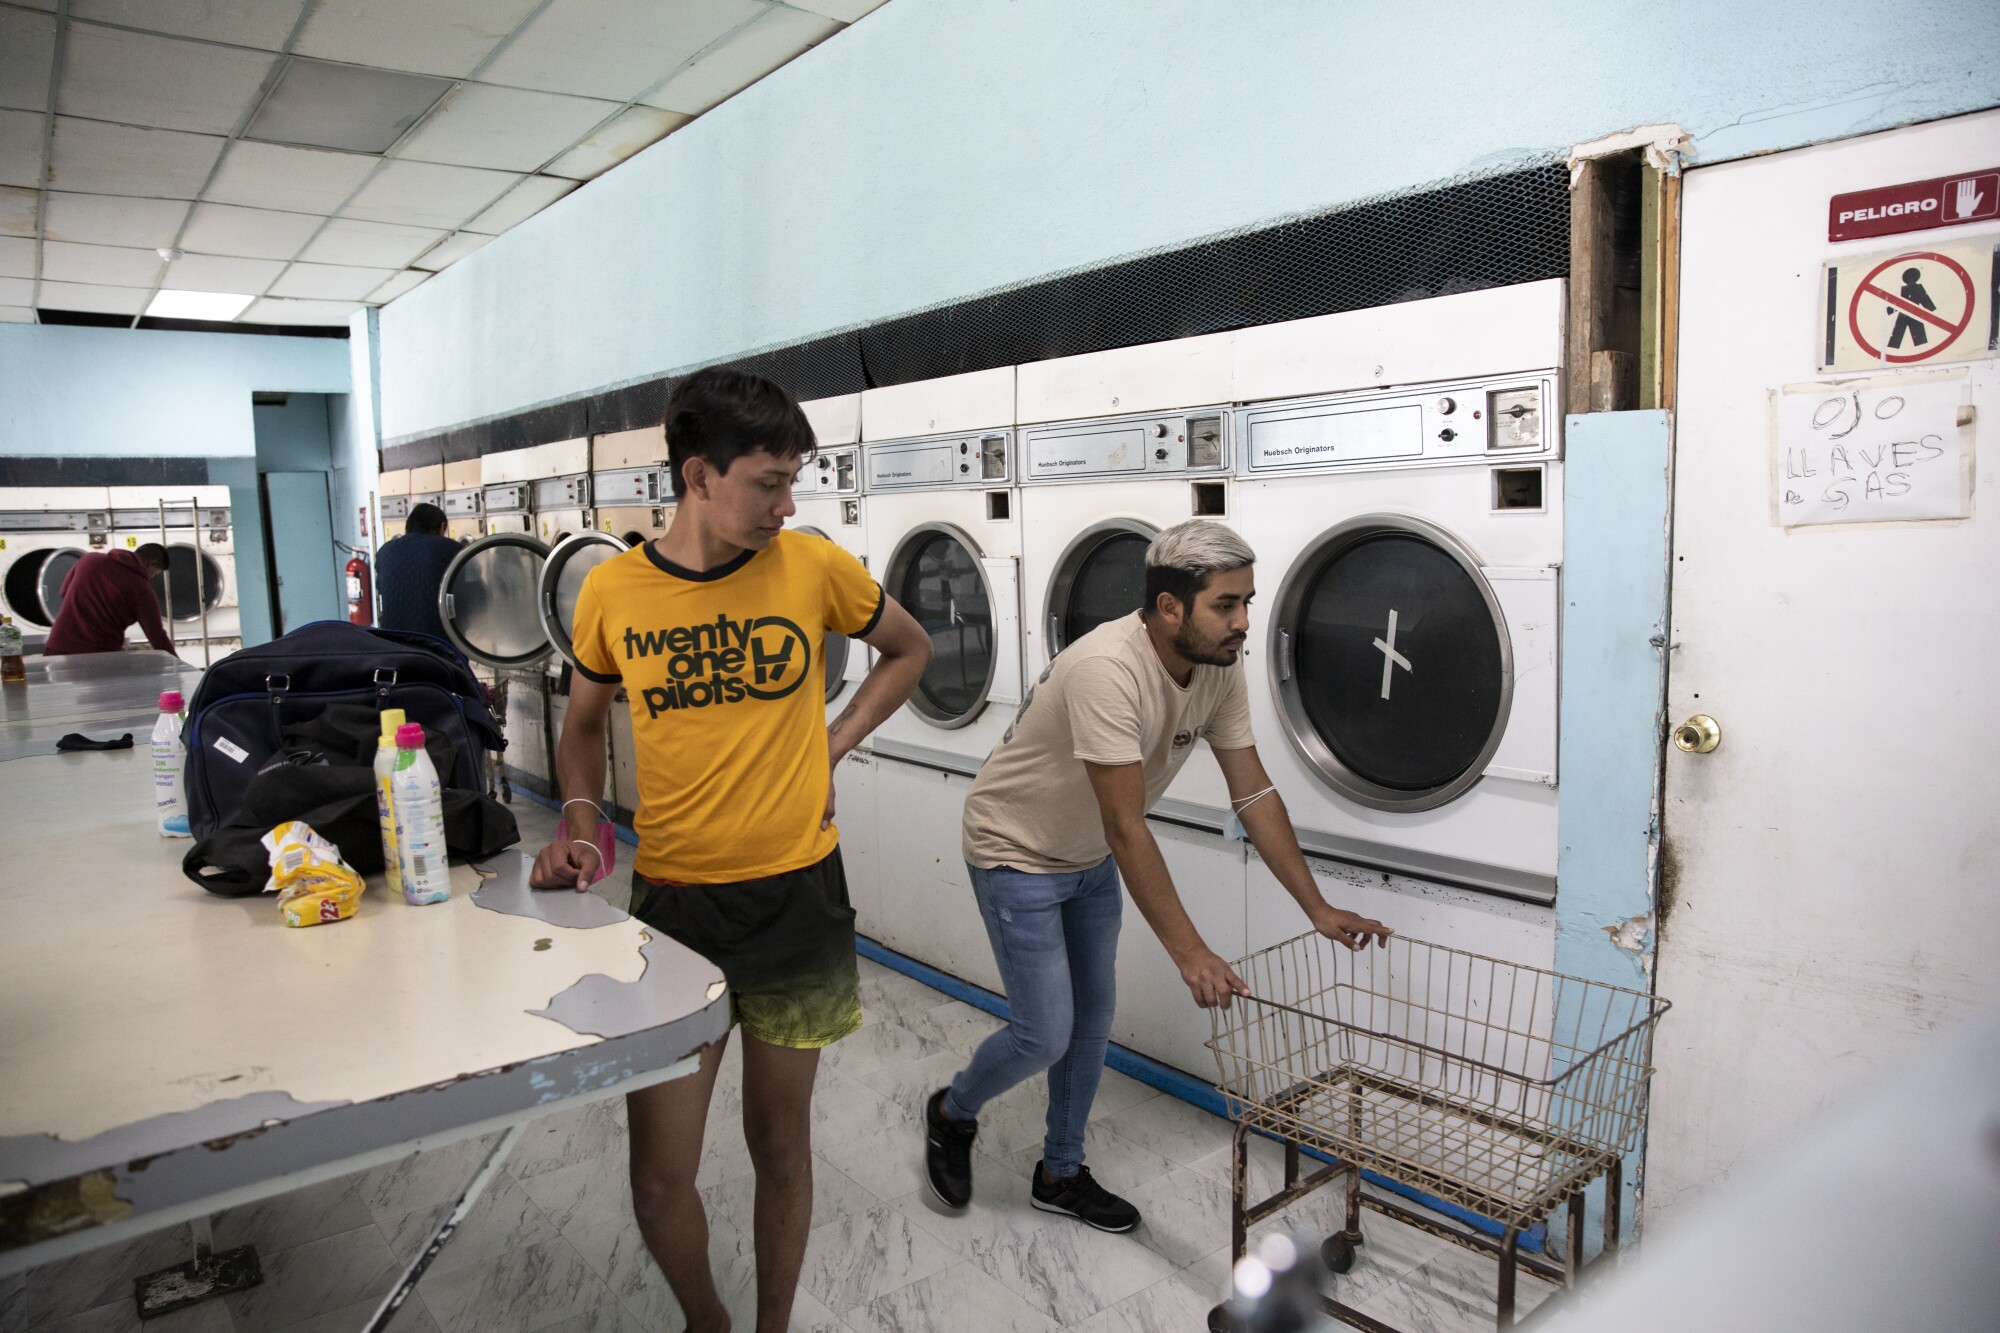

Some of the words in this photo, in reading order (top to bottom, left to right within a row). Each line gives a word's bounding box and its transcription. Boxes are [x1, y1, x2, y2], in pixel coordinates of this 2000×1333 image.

[1839, 198, 1938, 225] PELIGRO
[1811, 390, 1906, 440] OJO
[1058, 459, 1087, 467] Originators
[1263, 448, 1293, 457] Huebsch
[1294, 445, 1335, 455] Originators
[1786, 434, 1944, 480] LLAVES
[1821, 470, 1912, 512] GAS
[623, 613, 754, 660] twenty
[667, 646, 747, 680] one
[641, 671, 748, 720] pilots
